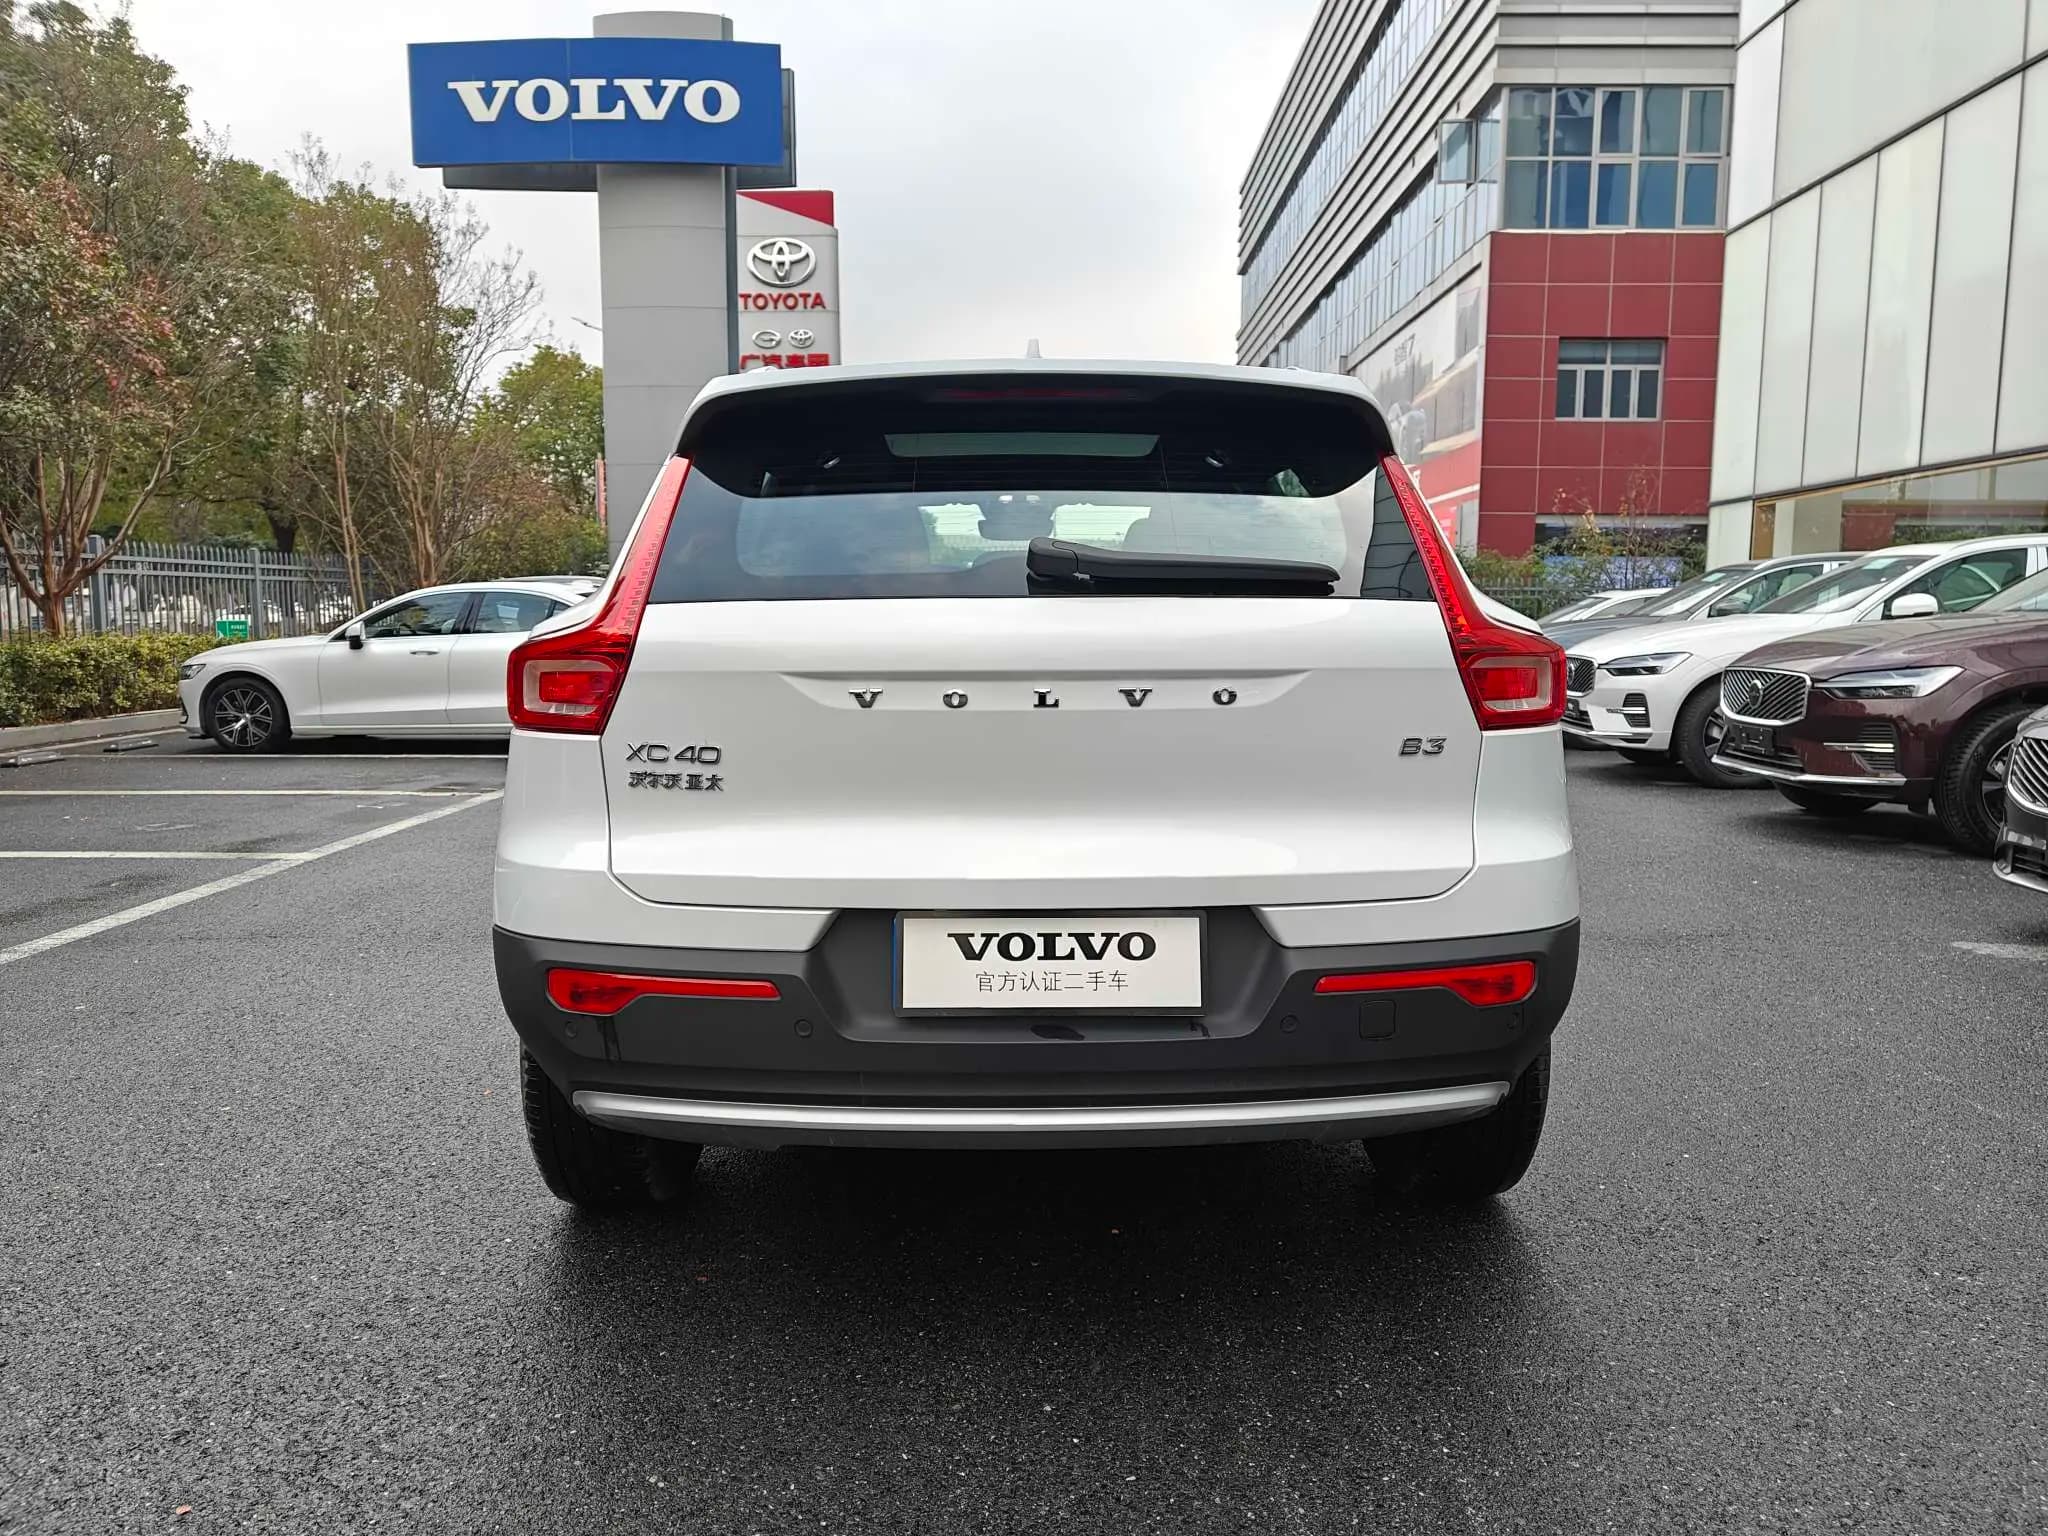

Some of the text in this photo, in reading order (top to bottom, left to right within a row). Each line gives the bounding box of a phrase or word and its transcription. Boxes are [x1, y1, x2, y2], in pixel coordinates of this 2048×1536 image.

[447, 78, 740, 122] VOLVO
[739, 293, 826, 310] TOYOTA
[848, 686, 1238, 709] VOLVO
[626, 743, 722, 764] XC40
[1400, 737, 1447, 755] B3
[628, 771, 724, 791] 沃尔沃亚太
[947, 932, 1157, 962] VOLVO
[975, 970, 1129, 992] 官方认证二手车
